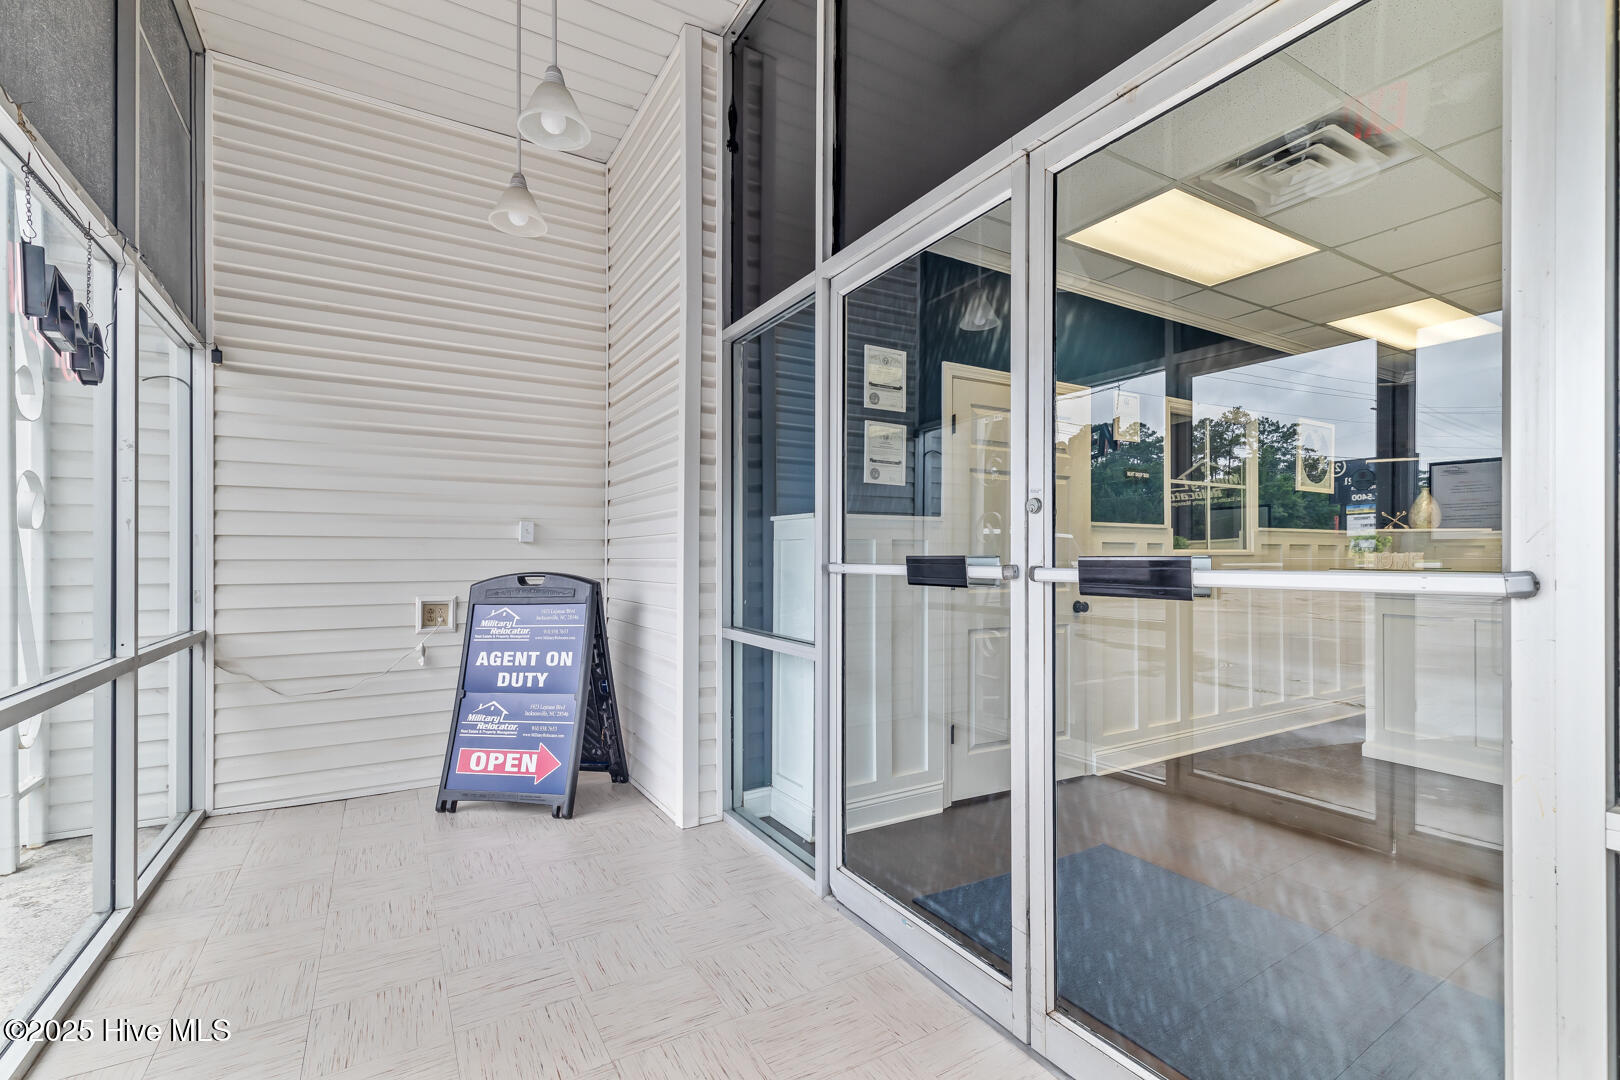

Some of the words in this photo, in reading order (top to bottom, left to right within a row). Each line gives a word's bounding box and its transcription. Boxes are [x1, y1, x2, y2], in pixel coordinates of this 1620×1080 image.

[480, 619, 512, 628] Military
[475, 651, 540, 666] AGENT
[546, 651, 573, 667] ON
[496, 672, 549, 687] DUTY
[467, 713, 501, 724] Military
[469, 751, 538, 773] OPEN
